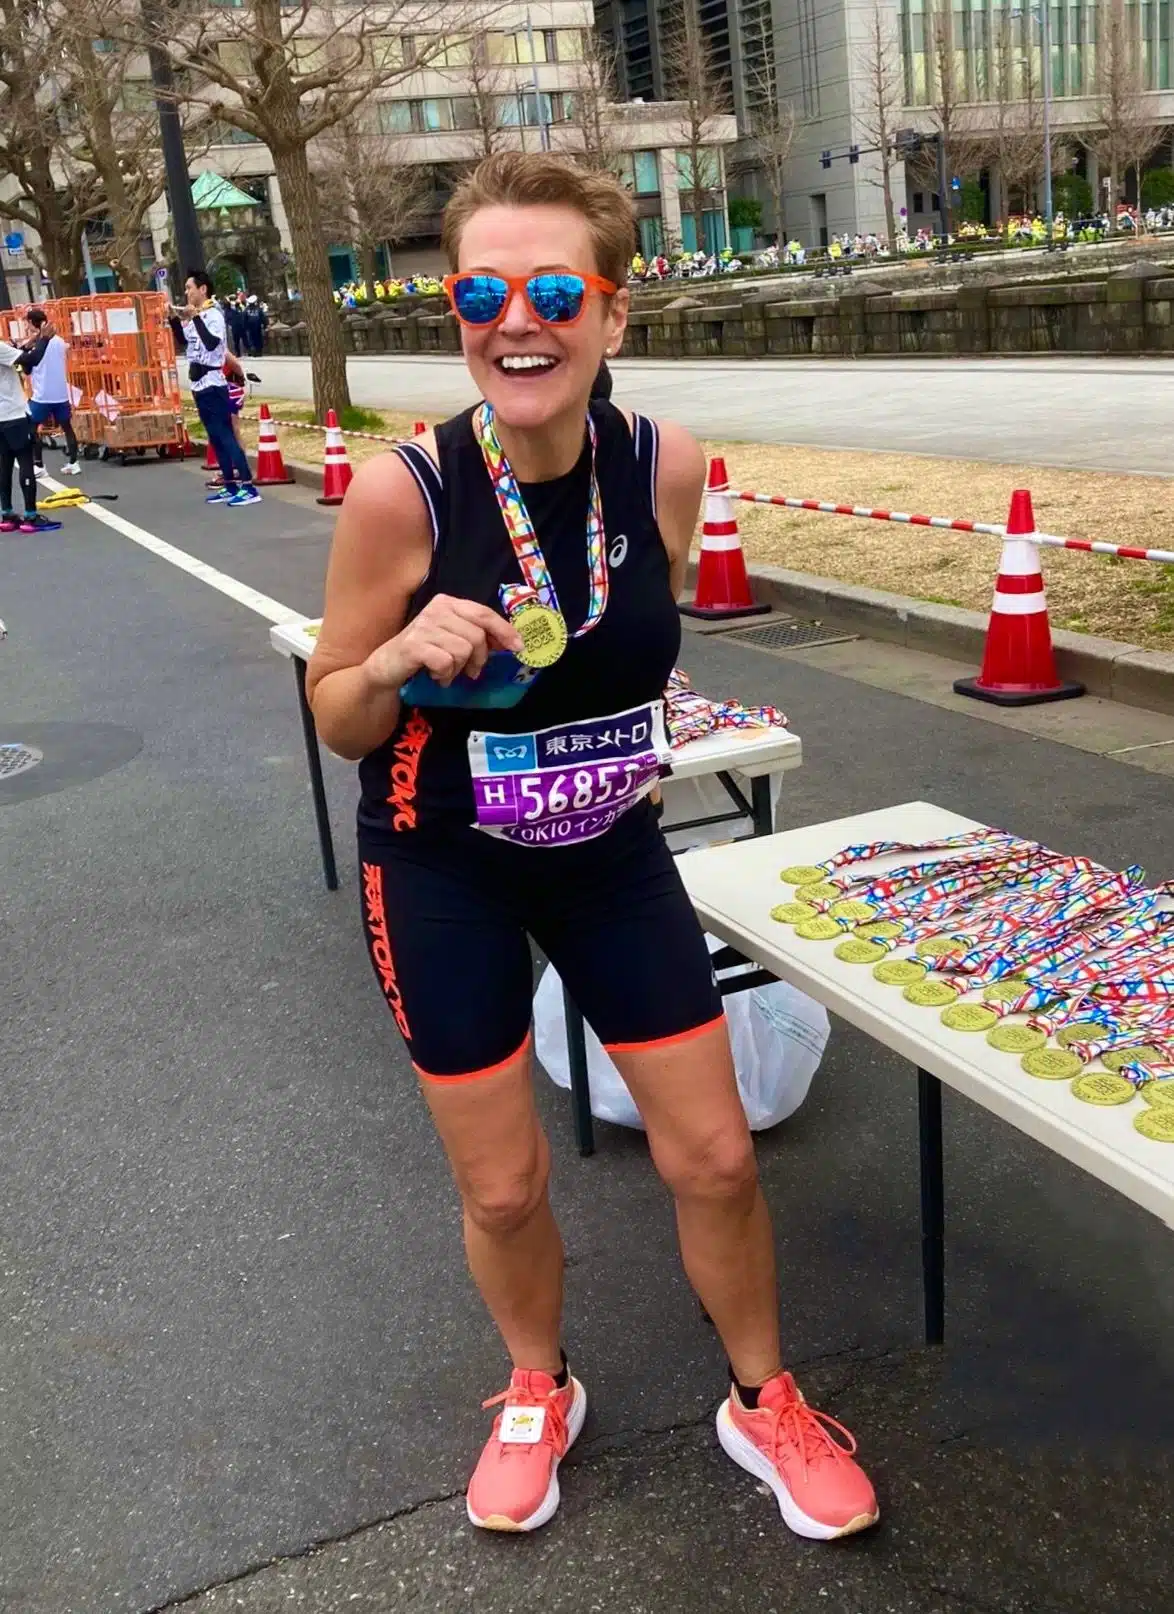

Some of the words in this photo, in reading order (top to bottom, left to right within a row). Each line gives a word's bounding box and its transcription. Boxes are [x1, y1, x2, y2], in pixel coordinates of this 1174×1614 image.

[545, 722, 648, 756] 東京メトロ
[484, 783, 505, 805] H
